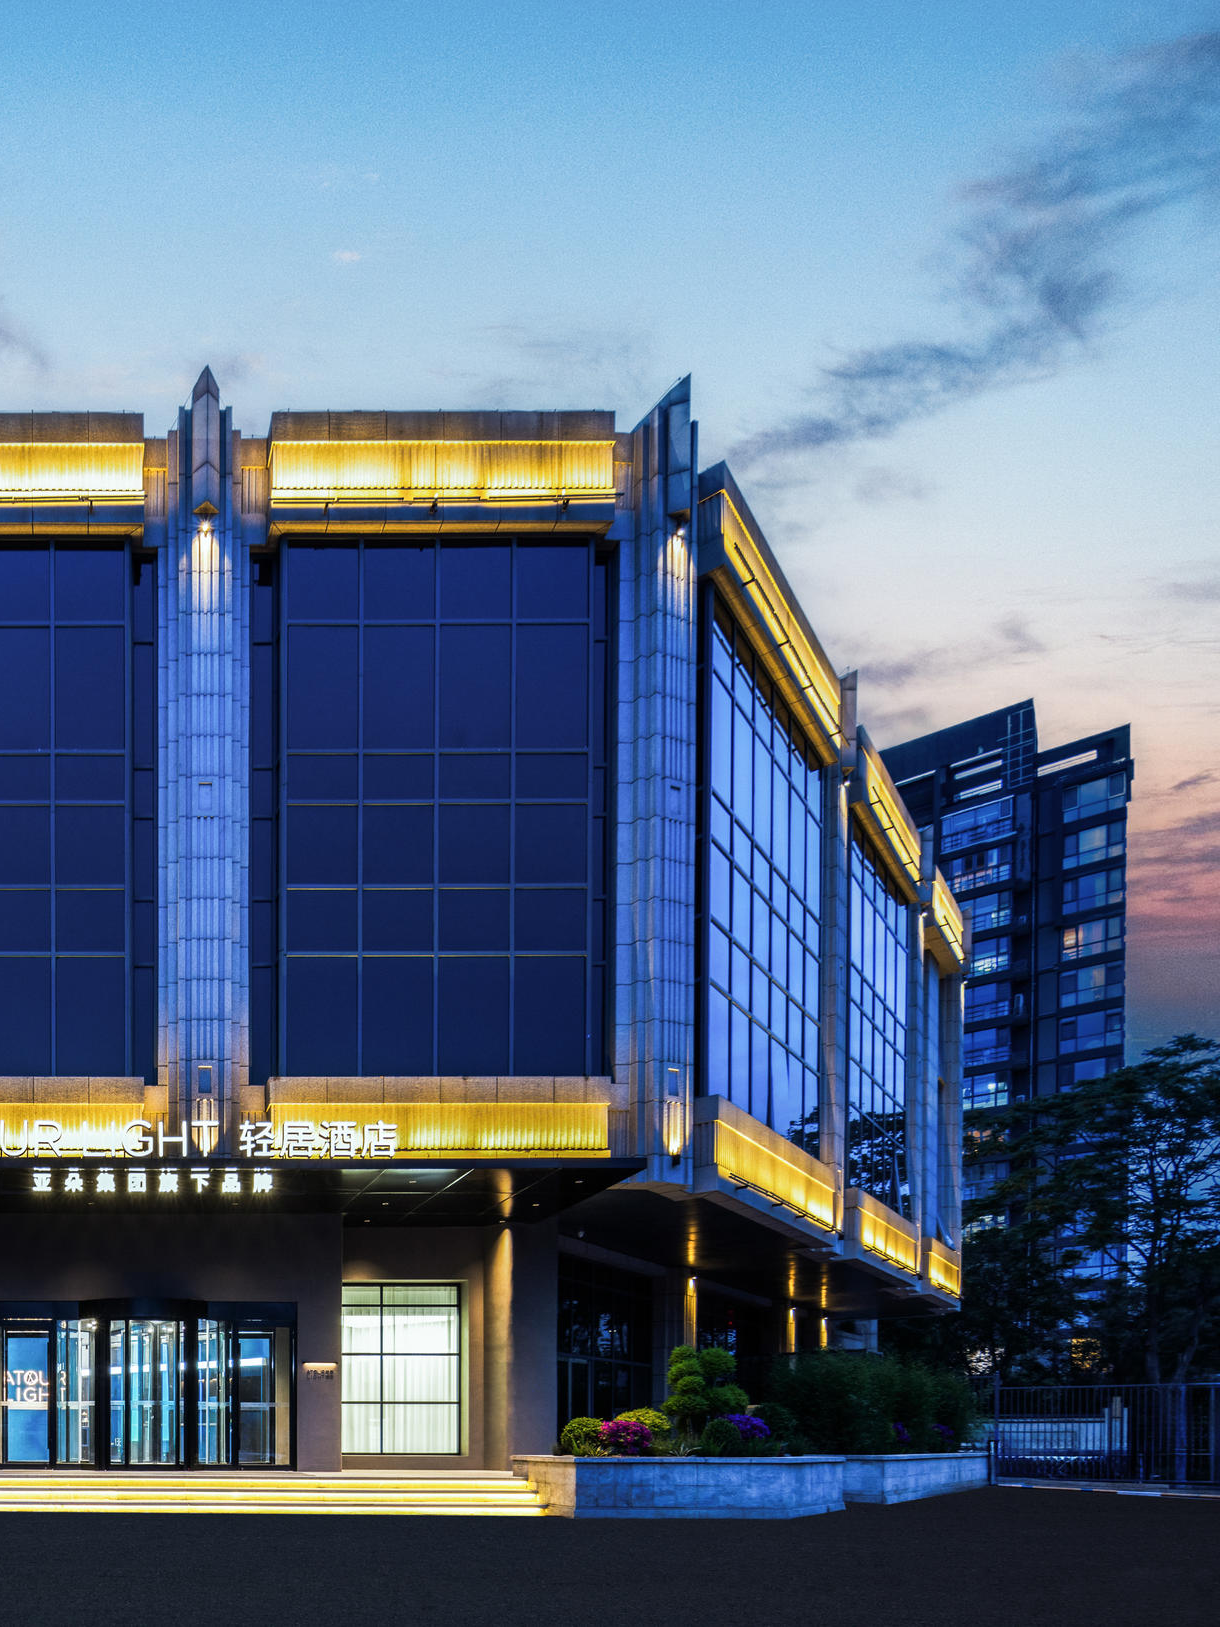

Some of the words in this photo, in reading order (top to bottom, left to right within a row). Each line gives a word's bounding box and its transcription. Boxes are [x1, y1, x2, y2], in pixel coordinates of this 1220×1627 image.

[81, 1119, 220, 1158] LIGHT
[238, 1119, 399, 1158] 轻居酒店
[32, 1172, 274, 1193] 亚朵集团旗下品牌
